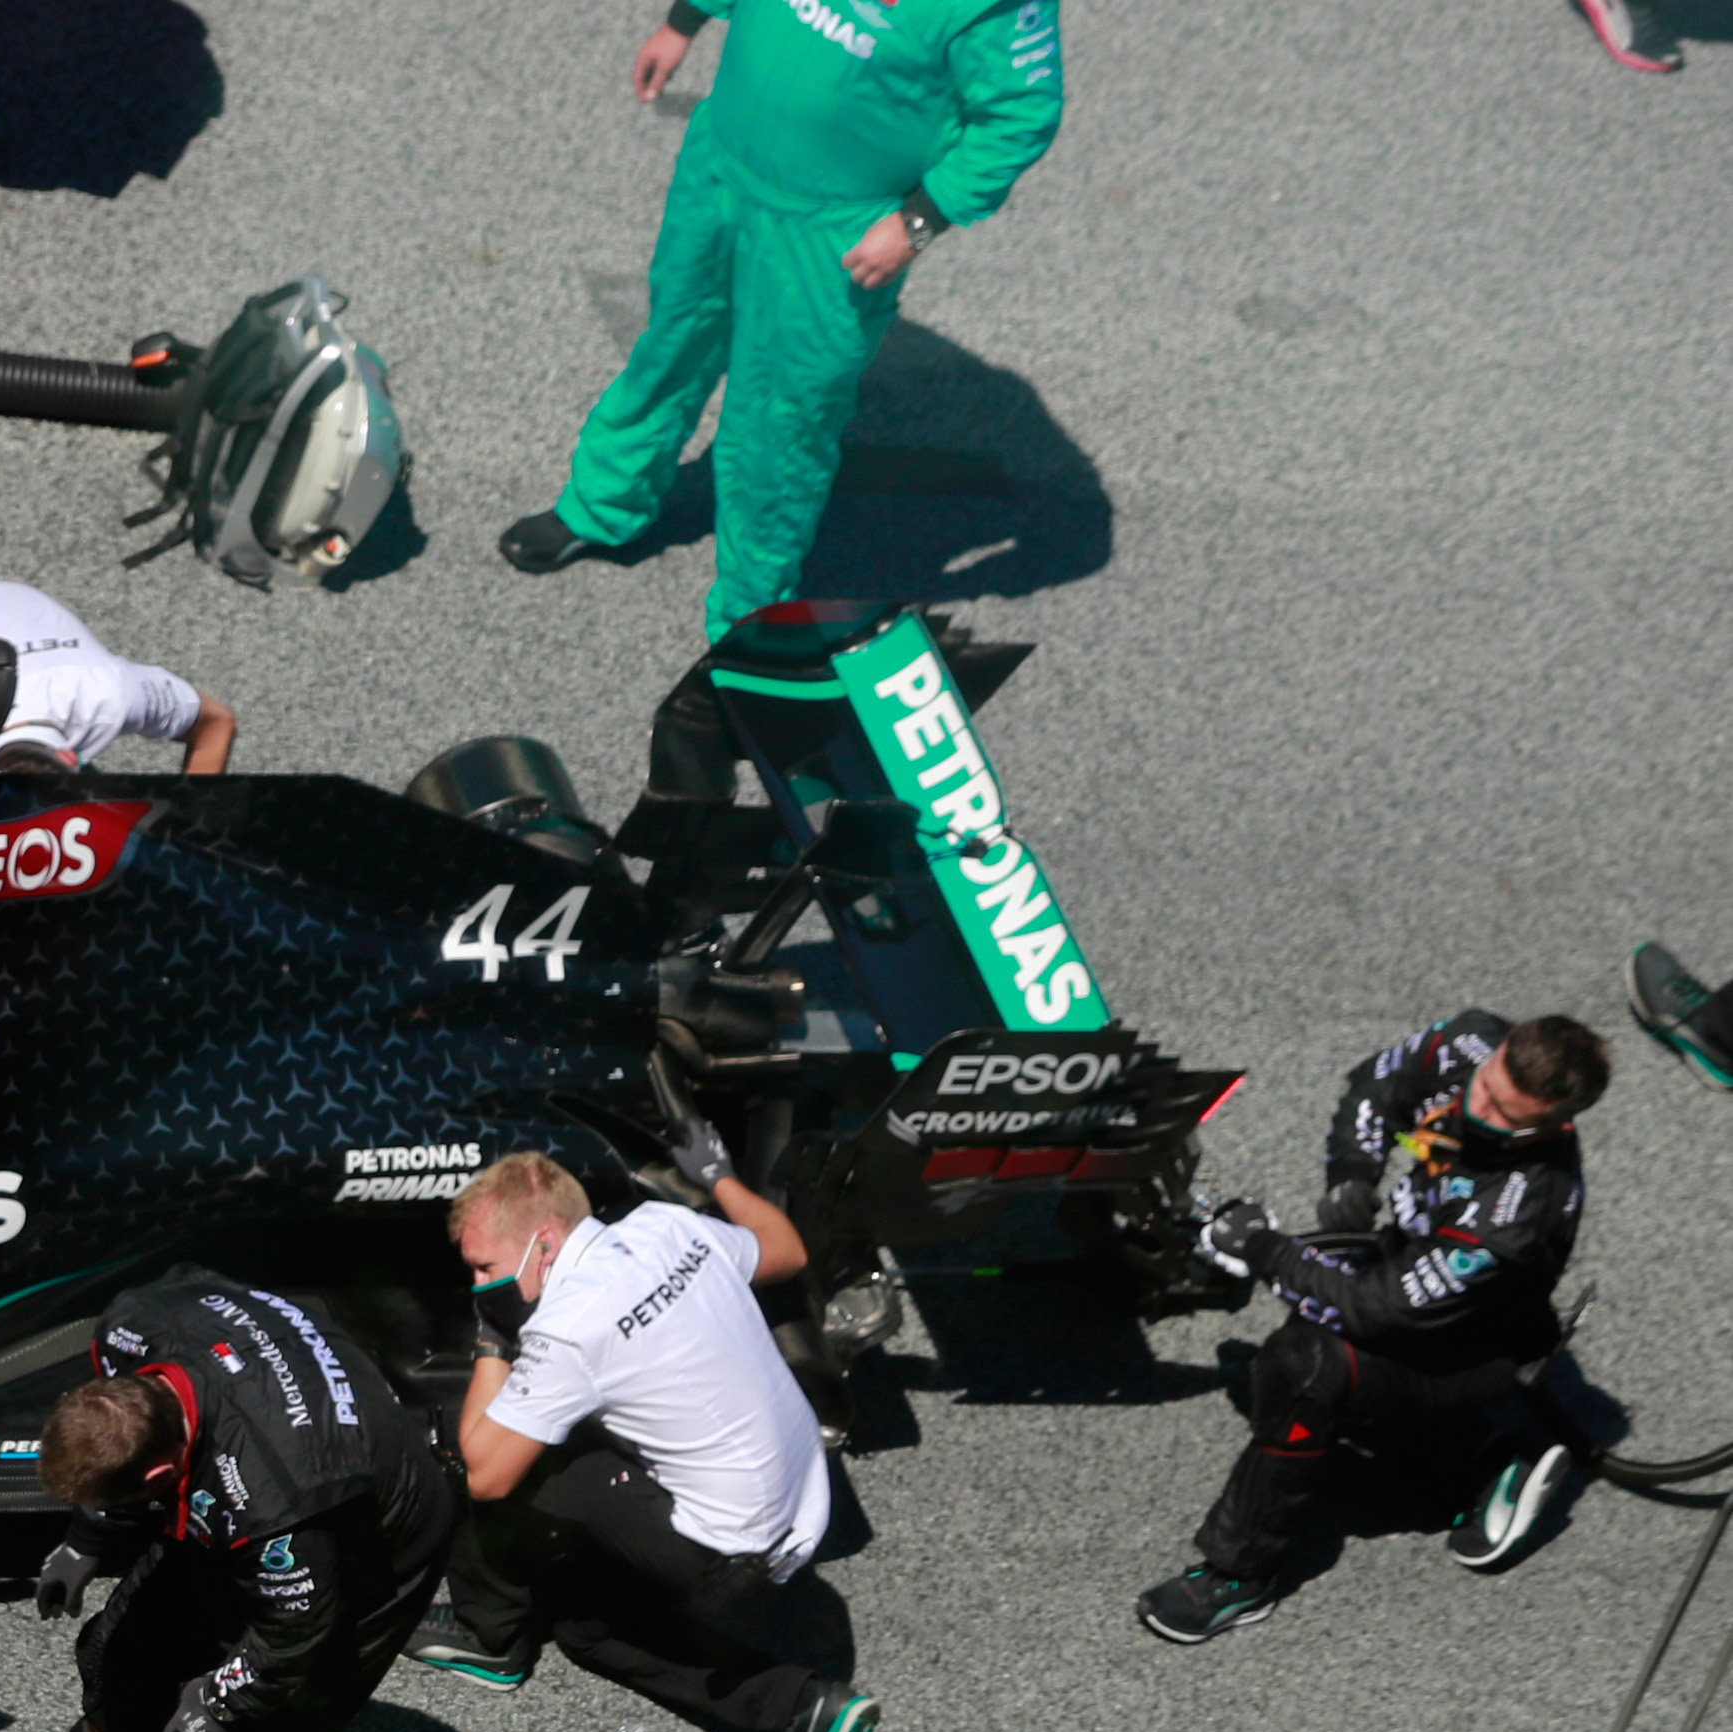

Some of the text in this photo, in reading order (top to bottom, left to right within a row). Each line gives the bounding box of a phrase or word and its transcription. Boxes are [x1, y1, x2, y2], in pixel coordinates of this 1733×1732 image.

[21, 638, 79, 654] PET
[874, 650, 1092, 1026] PETRONAS
[440, 884, 592, 983] 44
[346, 1143, 482, 1174] PETRONAS
[616, 1238, 713, 1341] PETRONAS
[199, 1293, 314, 1429] Mercedes-AMG
[248, 1289, 360, 1426] PETRONAS
